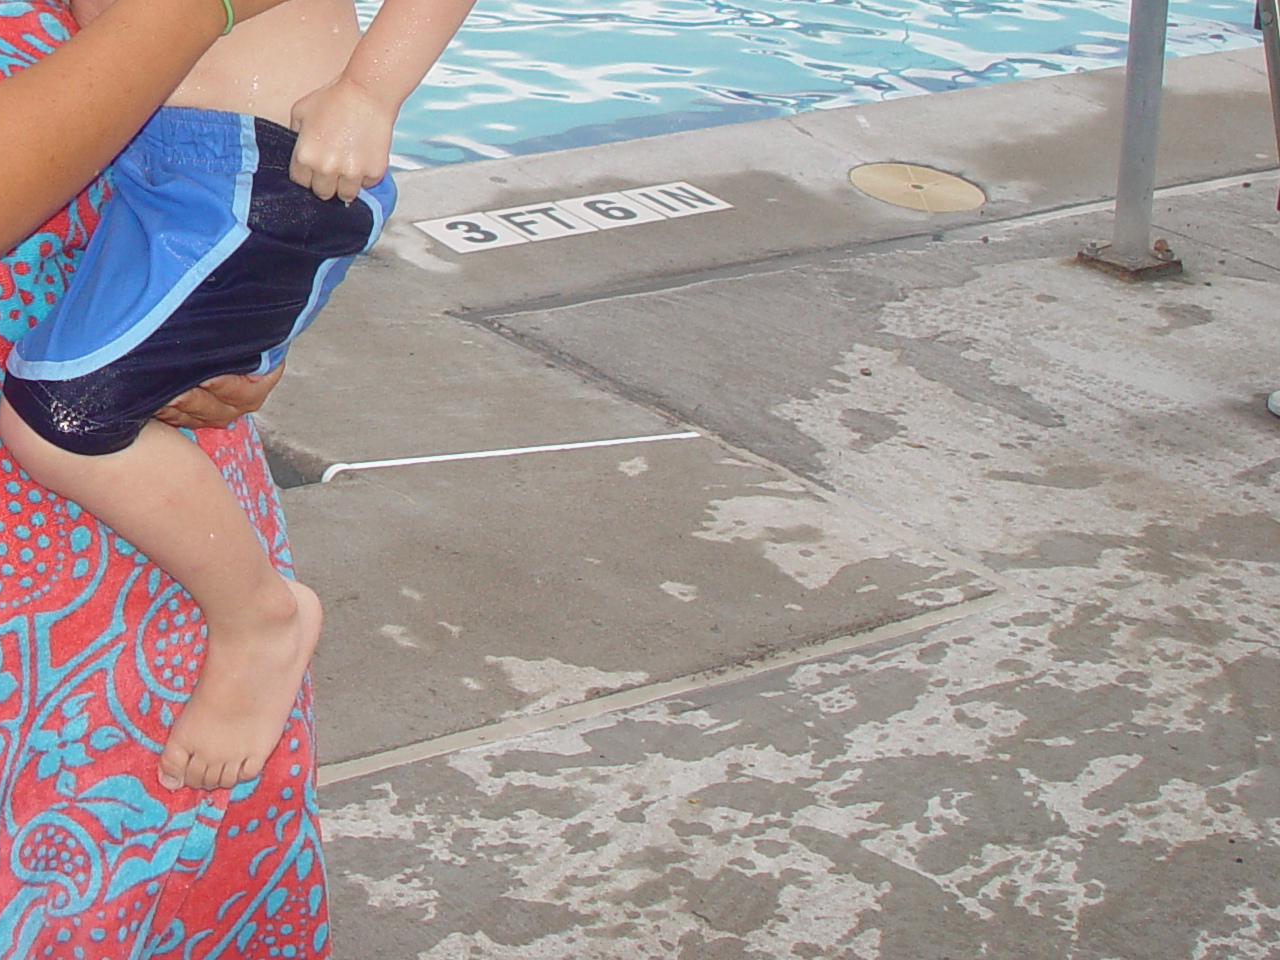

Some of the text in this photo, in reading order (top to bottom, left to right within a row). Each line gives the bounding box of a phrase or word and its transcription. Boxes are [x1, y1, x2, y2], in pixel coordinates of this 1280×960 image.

[444, 186, 718, 244] 3 FT 6 IN
